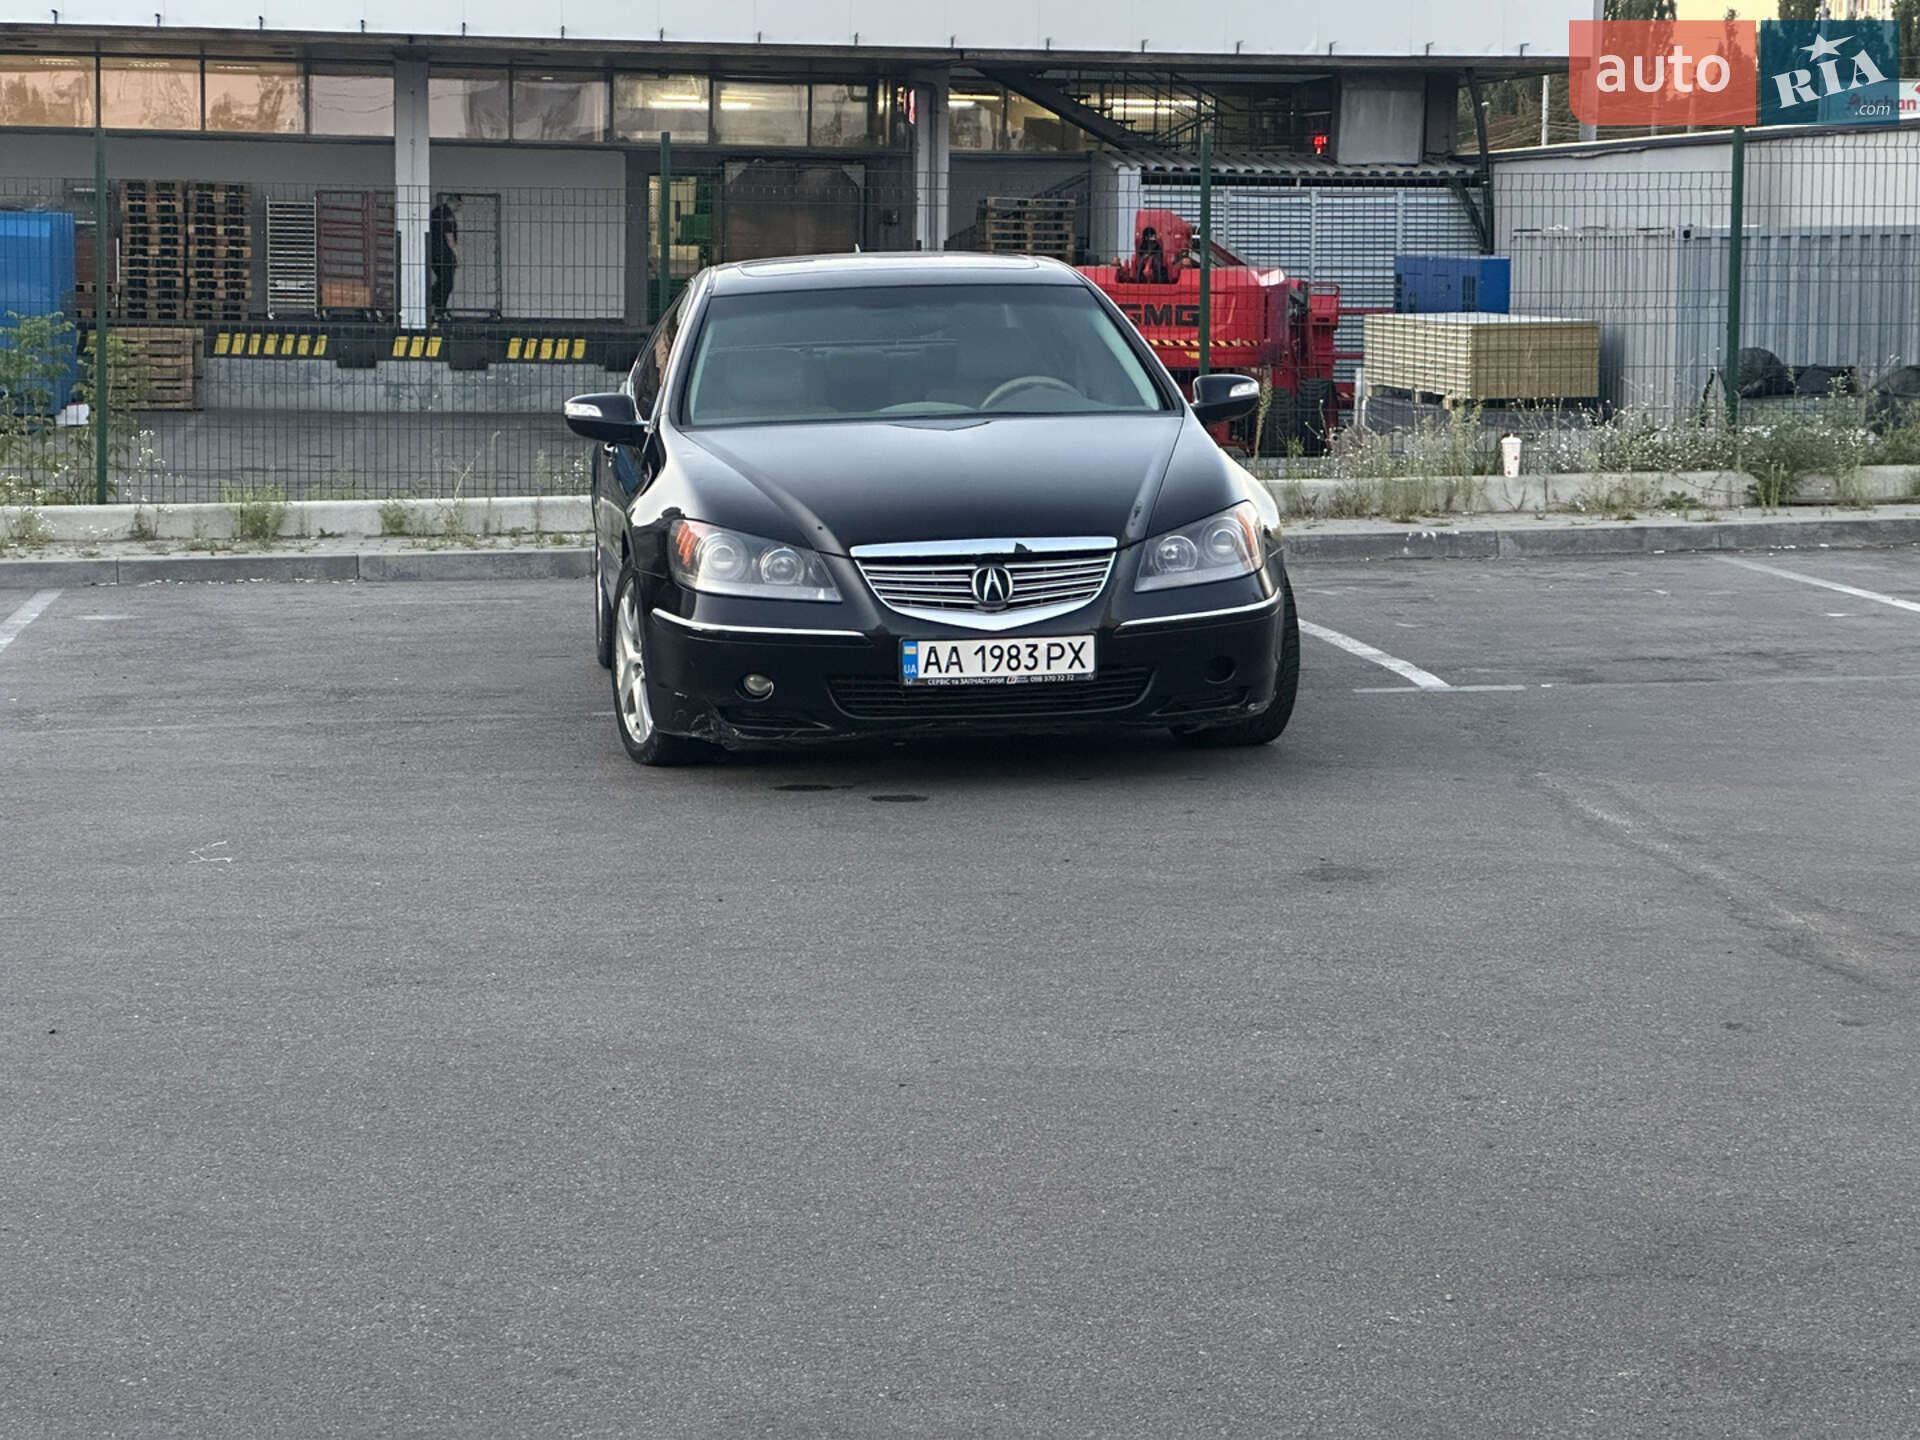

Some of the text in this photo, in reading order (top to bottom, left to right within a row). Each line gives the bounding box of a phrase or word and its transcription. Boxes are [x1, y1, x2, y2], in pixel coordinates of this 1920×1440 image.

[923, 641, 1087, 674] AA 1983 PX
[904, 664, 917, 674] UA
